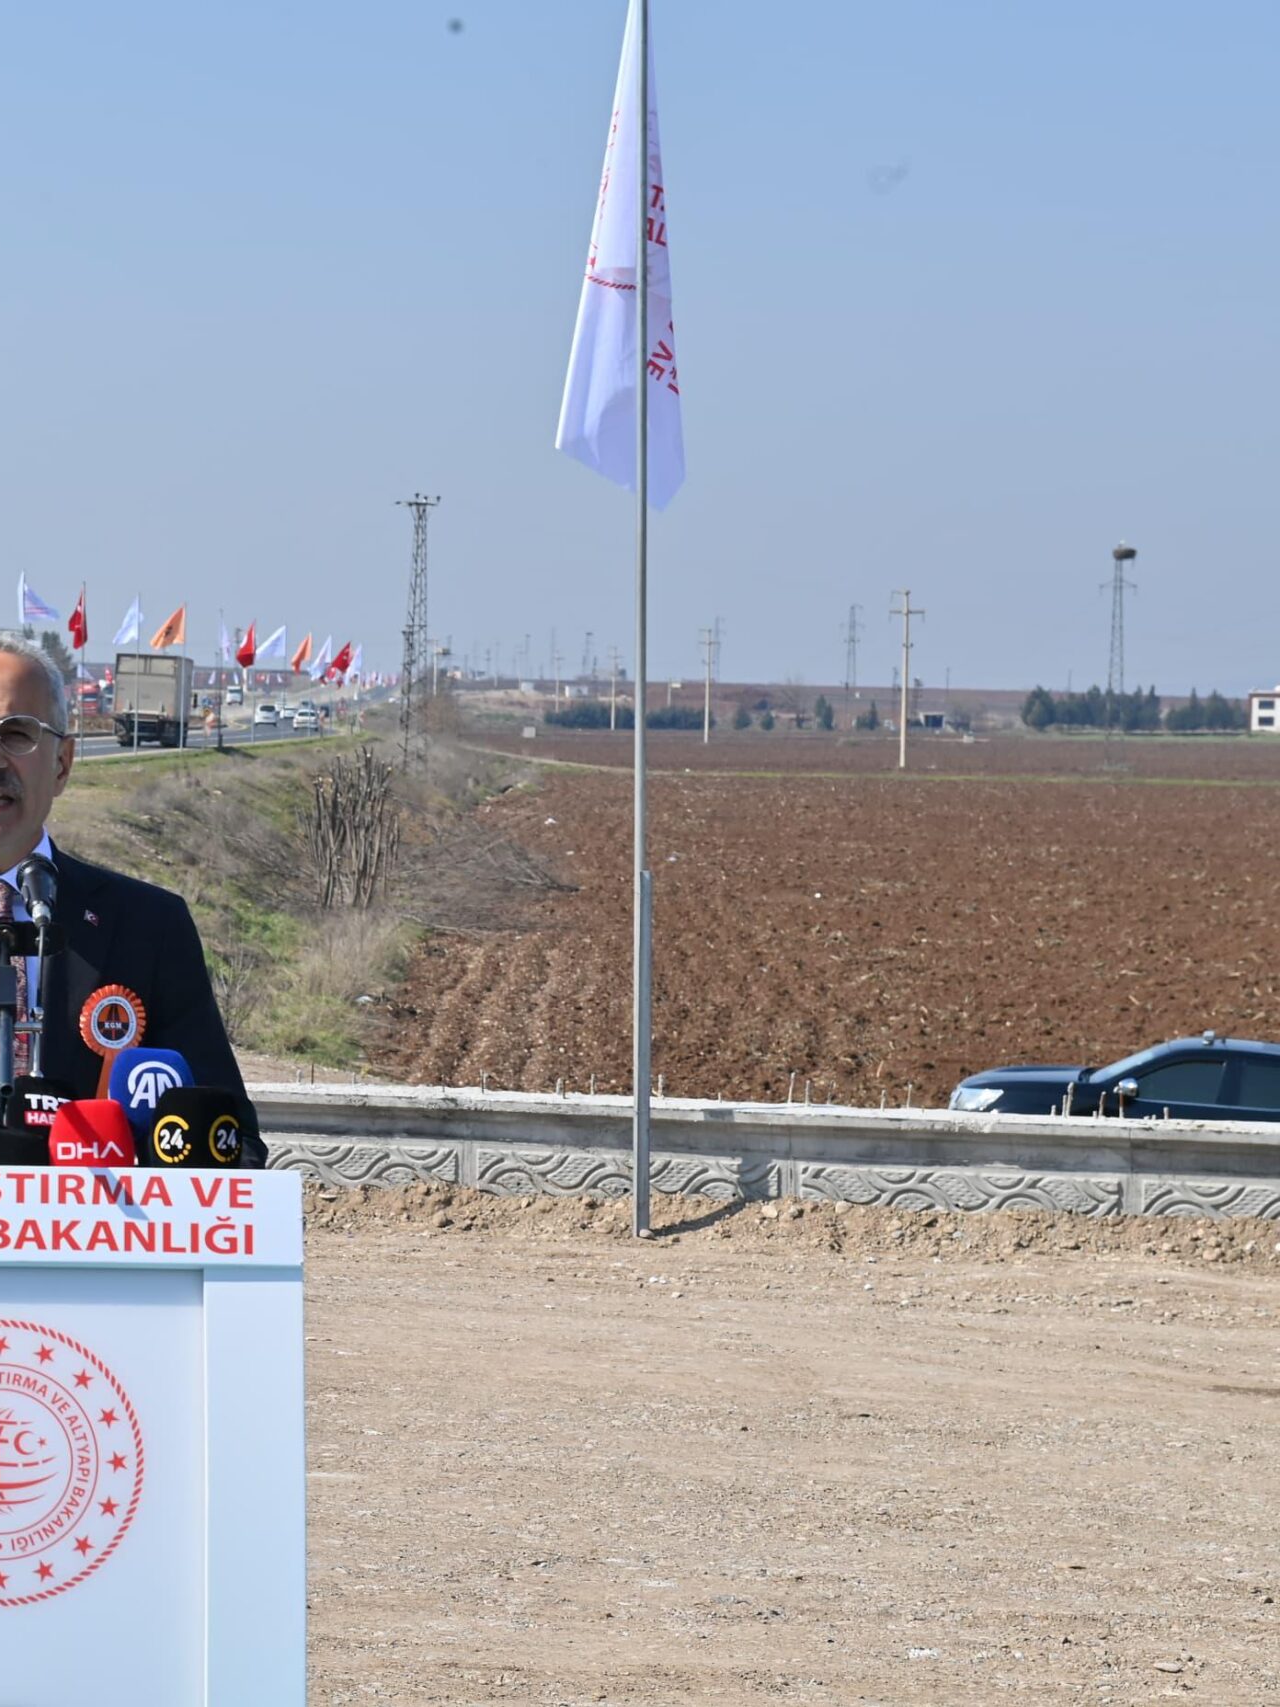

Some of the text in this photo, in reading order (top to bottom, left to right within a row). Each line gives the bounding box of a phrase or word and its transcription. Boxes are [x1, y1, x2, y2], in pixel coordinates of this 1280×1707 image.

[160, 1128, 184, 1150] 24
[217, 1128, 237, 1150] 24
[56, 1141, 124, 1161] DHA
[191, 1177, 254, 1209] VE
[51, 1392, 71, 1415] VE
[65, 1415, 92, 1483] ALTYAPI
[11, 1486, 86, 1553] BAKANLIĞI
